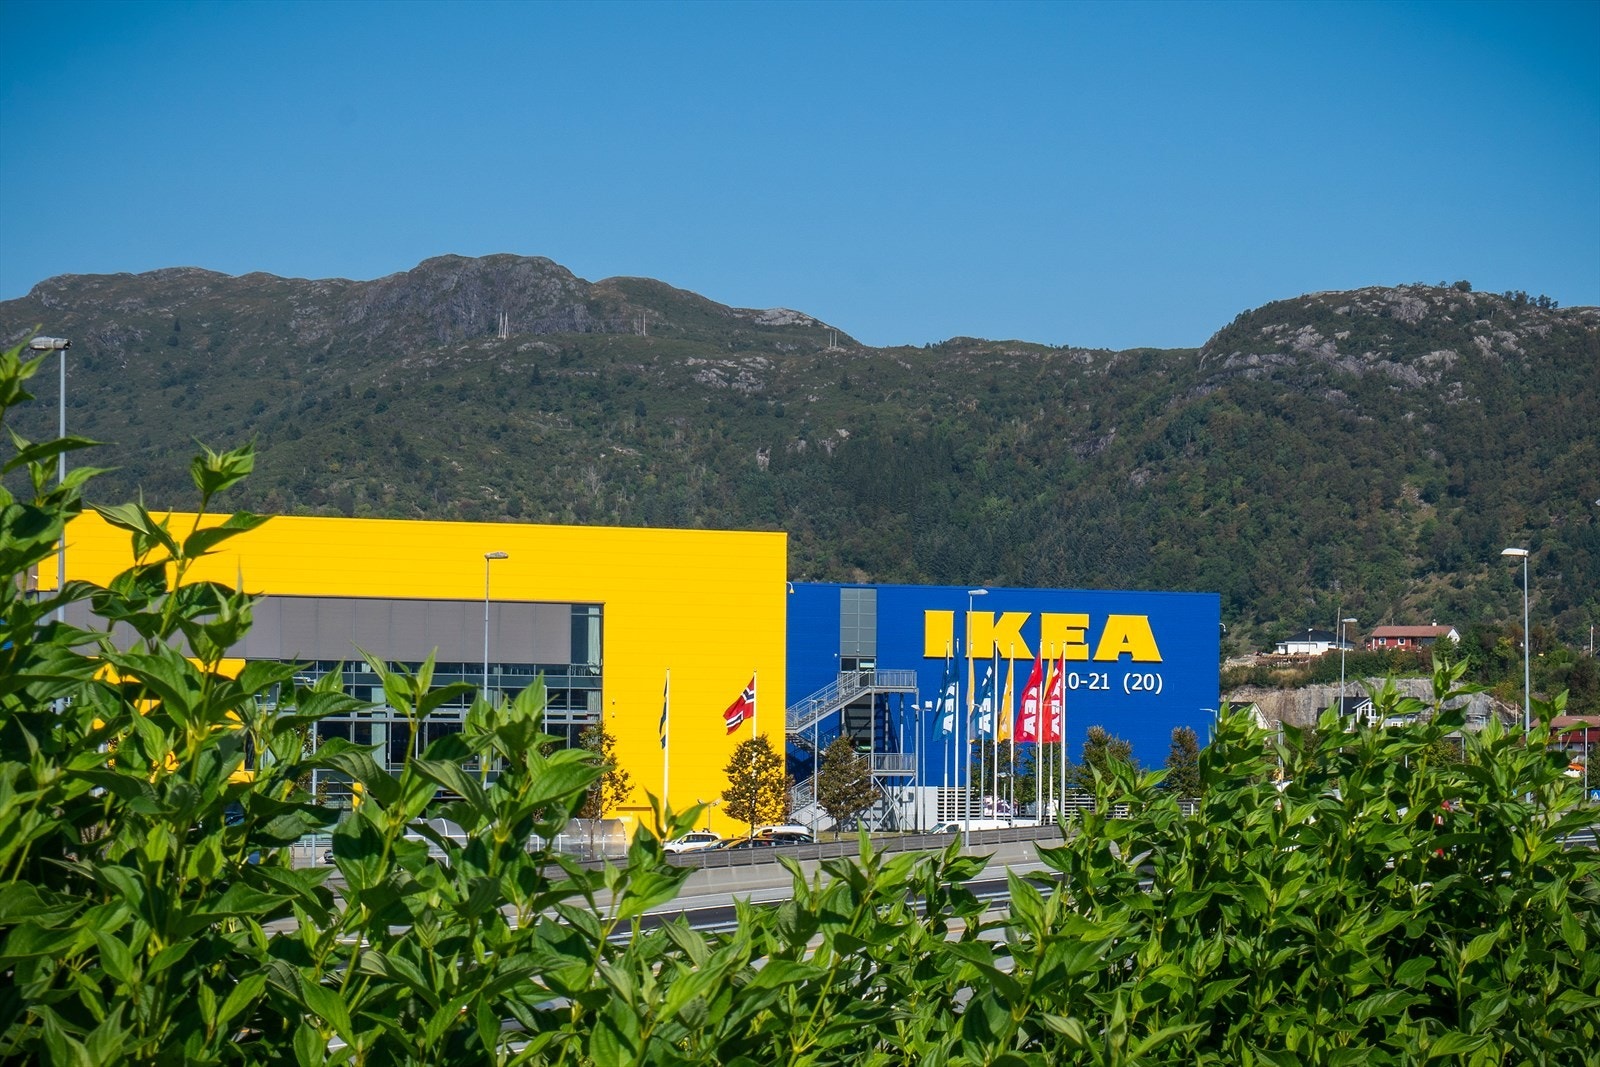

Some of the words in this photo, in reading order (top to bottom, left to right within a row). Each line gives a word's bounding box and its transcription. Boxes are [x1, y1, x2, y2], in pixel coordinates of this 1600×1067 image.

[924, 610, 1163, 662] IKEA
[1064, 672, 1110, 690] 0-21
[1123, 672, 1163, 695] (20)
